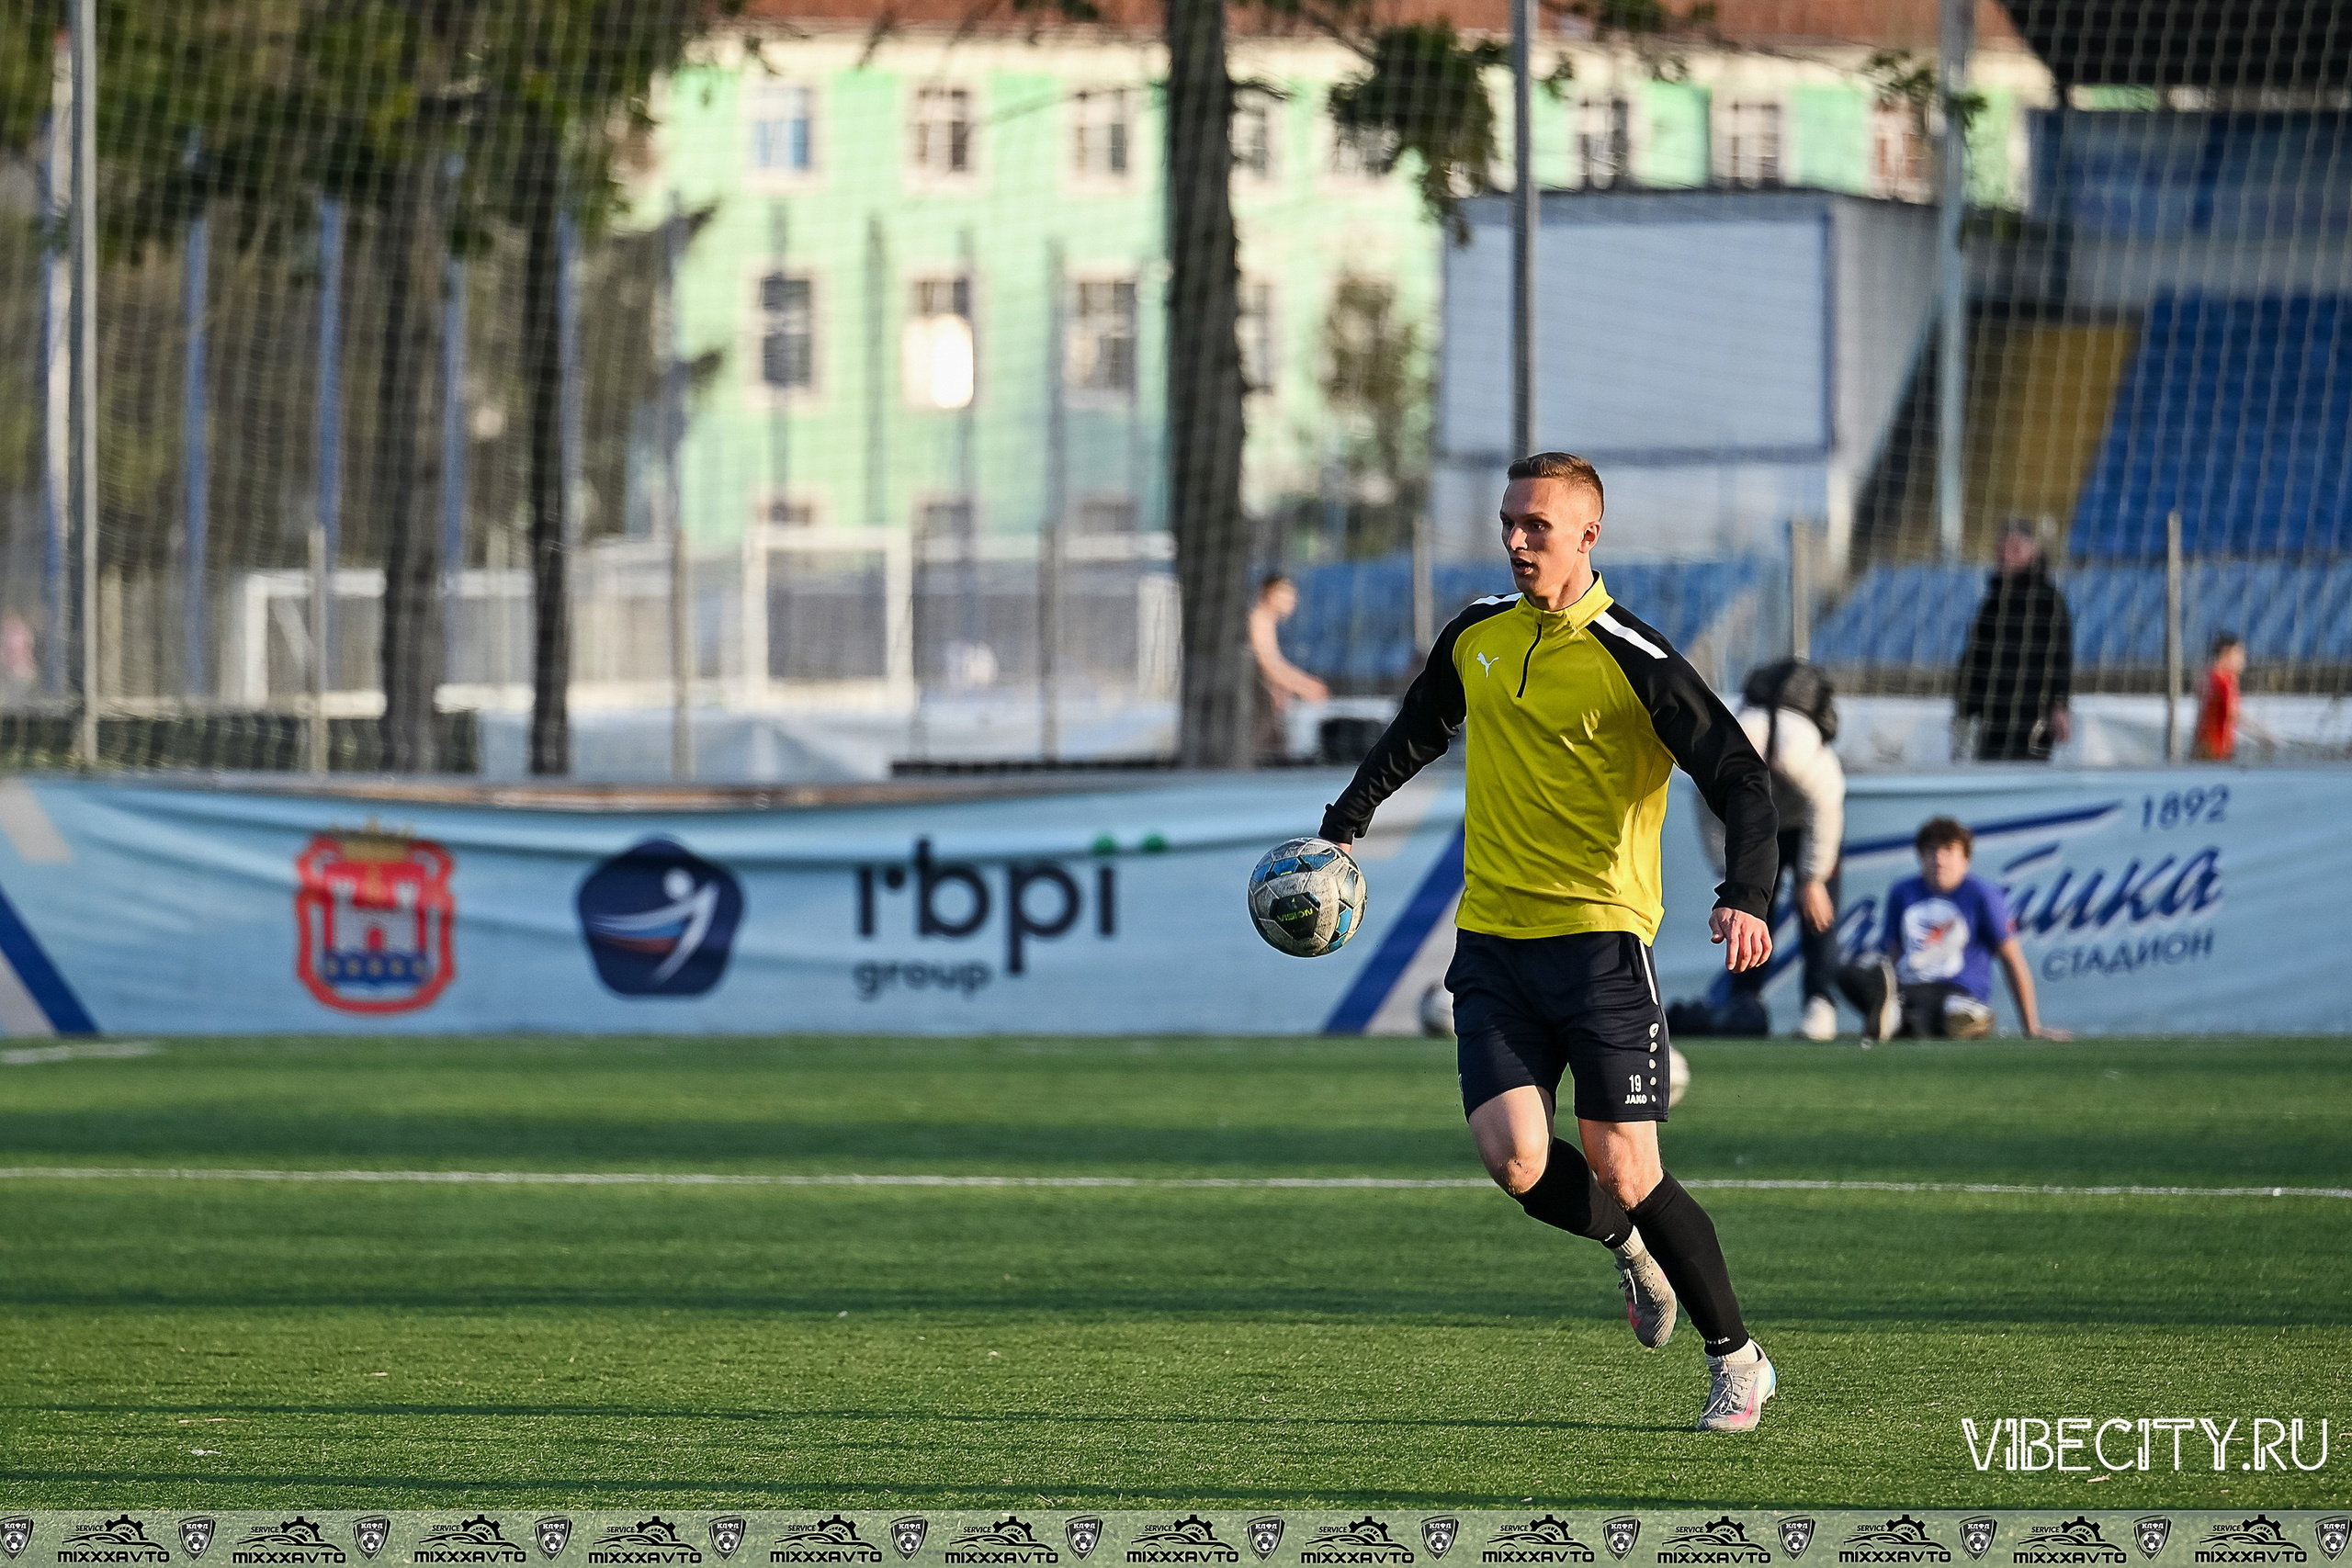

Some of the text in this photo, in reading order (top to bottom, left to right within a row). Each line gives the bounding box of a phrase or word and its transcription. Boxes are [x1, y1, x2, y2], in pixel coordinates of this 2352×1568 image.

[2141, 784, 2232, 829] 1892
[1276, 908, 1313, 922] VISION
[2042, 926, 2216, 983] СТАДИОН
[854, 958, 994, 1027] group
[1624, 1094, 1647, 1104] JAKO
[1629, 1074, 1642, 1093] 19
